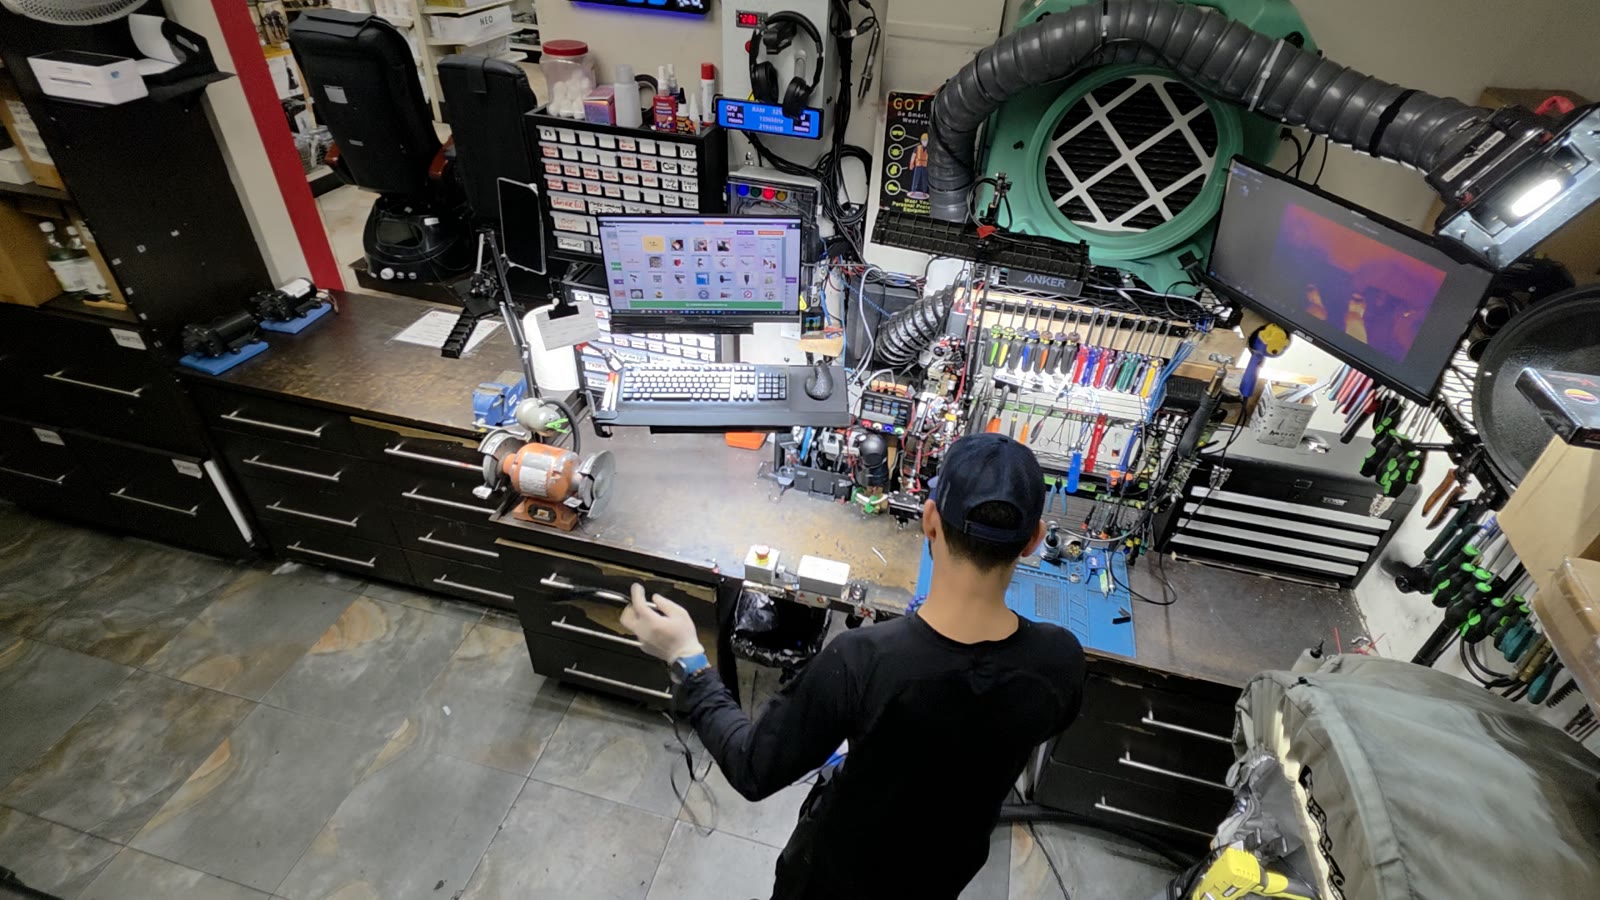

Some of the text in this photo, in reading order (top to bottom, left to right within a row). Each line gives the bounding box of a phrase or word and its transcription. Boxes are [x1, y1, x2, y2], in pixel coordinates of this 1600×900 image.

[480, 15, 493, 26] NEO
[726, 104, 738, 112] CPU
[893, 97, 925, 112] GOT
[1023, 273, 1066, 288] ANKER
